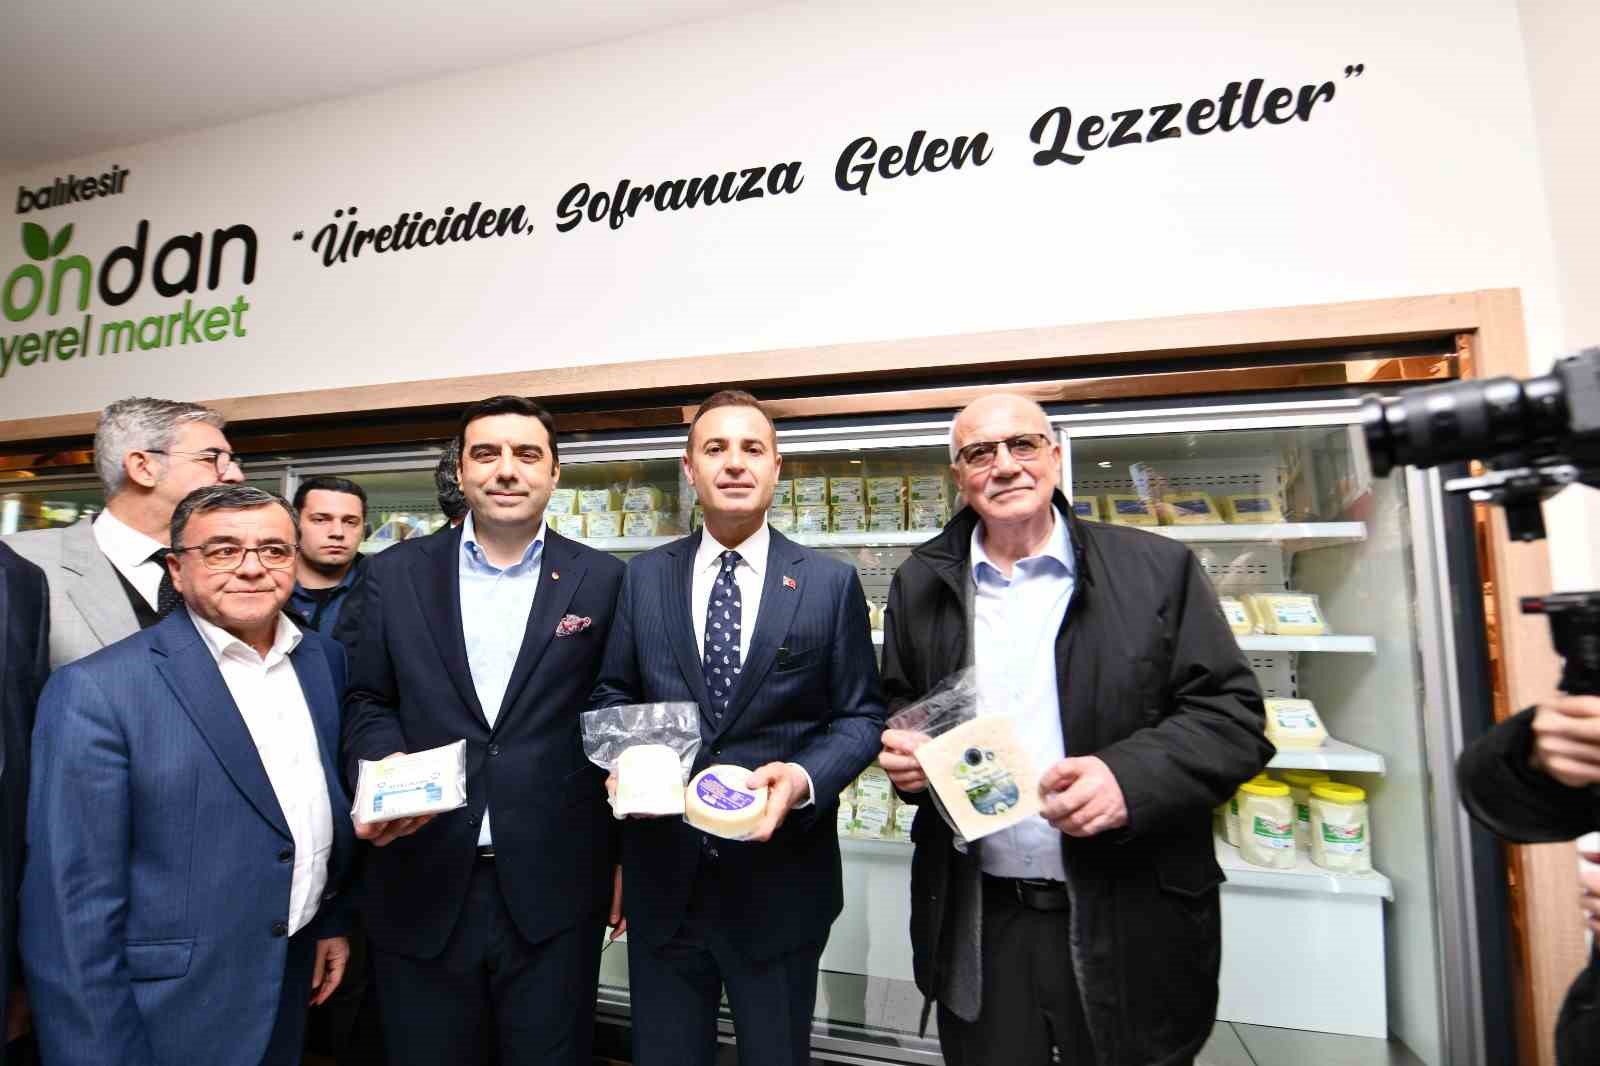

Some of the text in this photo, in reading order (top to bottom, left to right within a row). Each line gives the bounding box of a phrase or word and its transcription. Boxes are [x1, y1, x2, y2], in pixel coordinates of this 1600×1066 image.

[16, 164, 131, 214] balıkesir
[556, 161, 805, 232] Sofranıza
[834, 130, 994, 196] Gelen
[1, 219, 258, 322] ondan
[0, 295, 250, 378] yerel market
